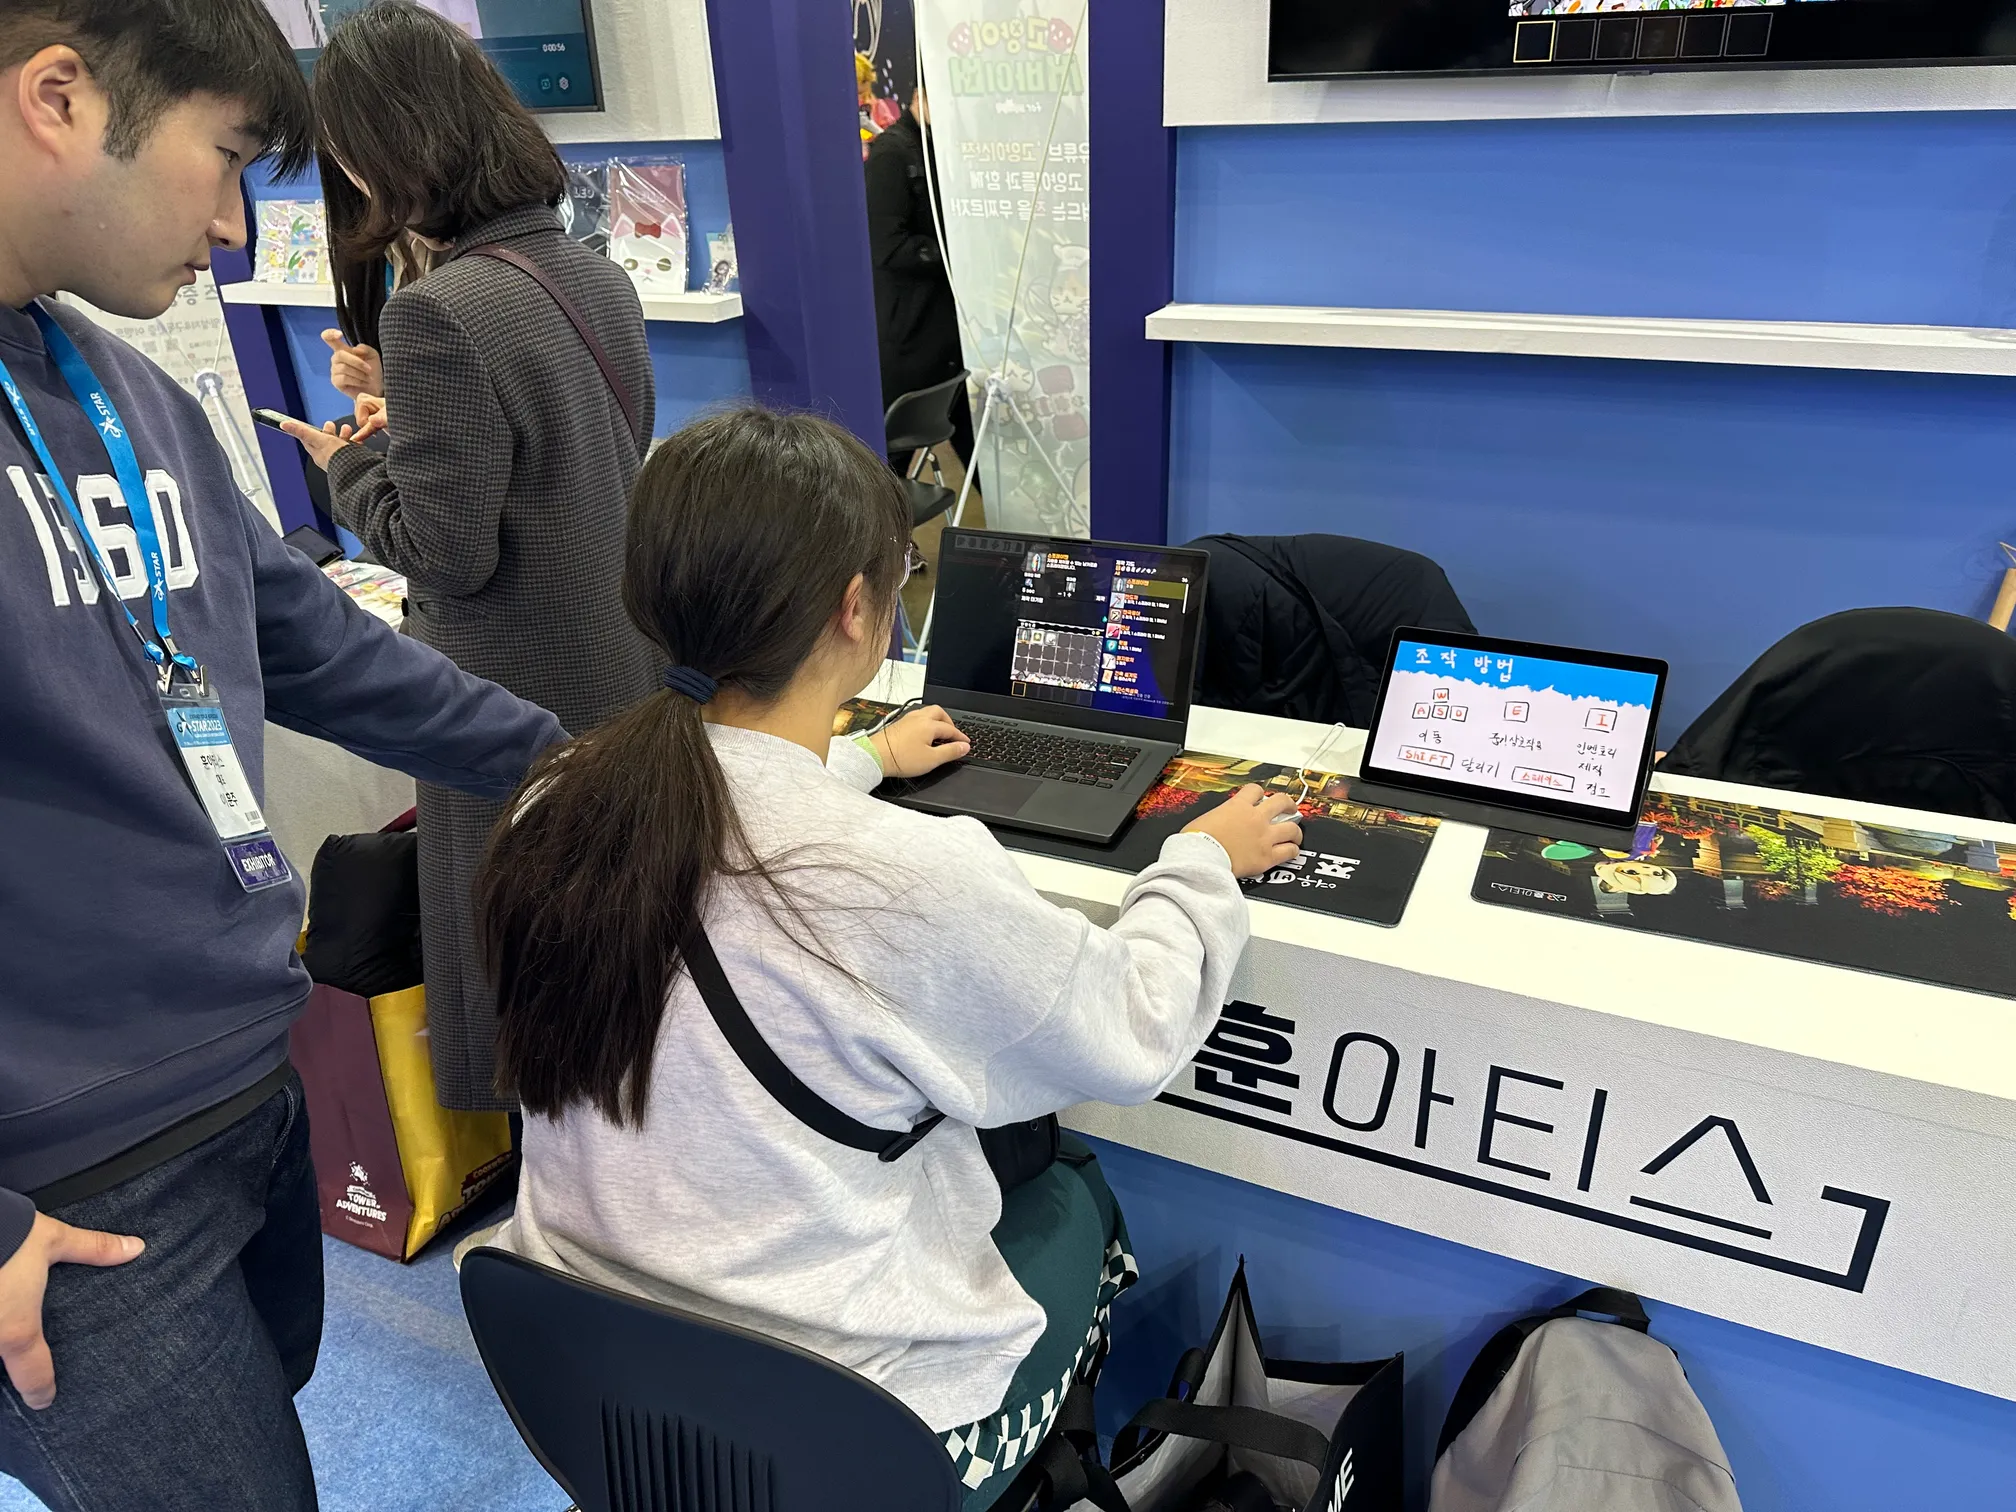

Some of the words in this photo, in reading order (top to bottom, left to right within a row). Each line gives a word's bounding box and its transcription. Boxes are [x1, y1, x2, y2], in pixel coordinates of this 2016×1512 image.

[1416, 648, 1457, 669] 조작
[1474, 655, 1514, 683] 방법
[1512, 705, 1523, 715] E
[1461, 757, 1500, 778] 달리기
[1578, 762, 1602, 777] 제작
[241, 852, 276, 873] EXHIBITOR
[1191, 999, 1775, 1241] 훈아티스
[335, 1199, 387, 1222] ADVENTURES
[346, 1192, 378, 1209] TOWER
